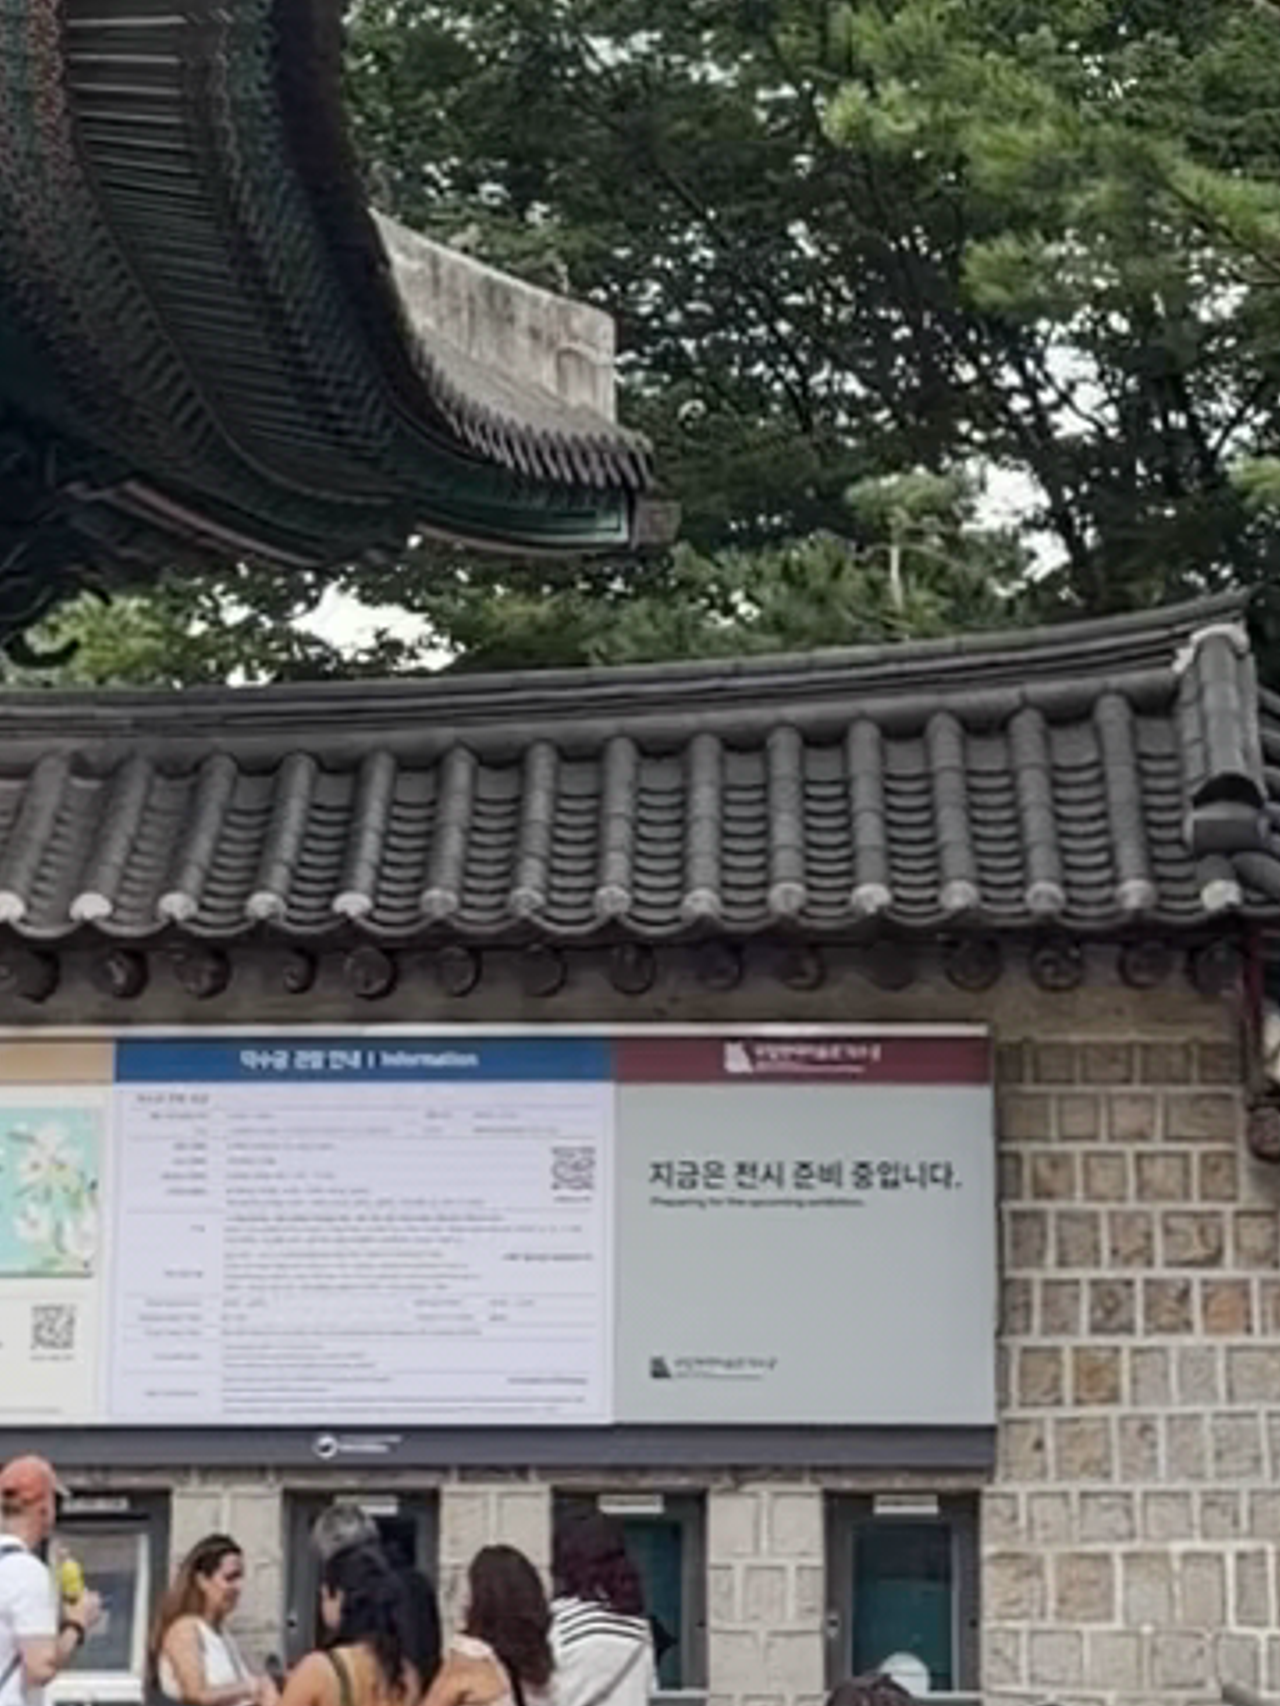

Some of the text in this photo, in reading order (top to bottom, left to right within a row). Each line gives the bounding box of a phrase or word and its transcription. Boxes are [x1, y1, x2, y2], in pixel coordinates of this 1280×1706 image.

[379, 1050, 480, 1068] Information
[649, 1159, 964, 1190] 지금은 전시 준비 중입니다.
[649, 1195, 706, 1210] Preparing
